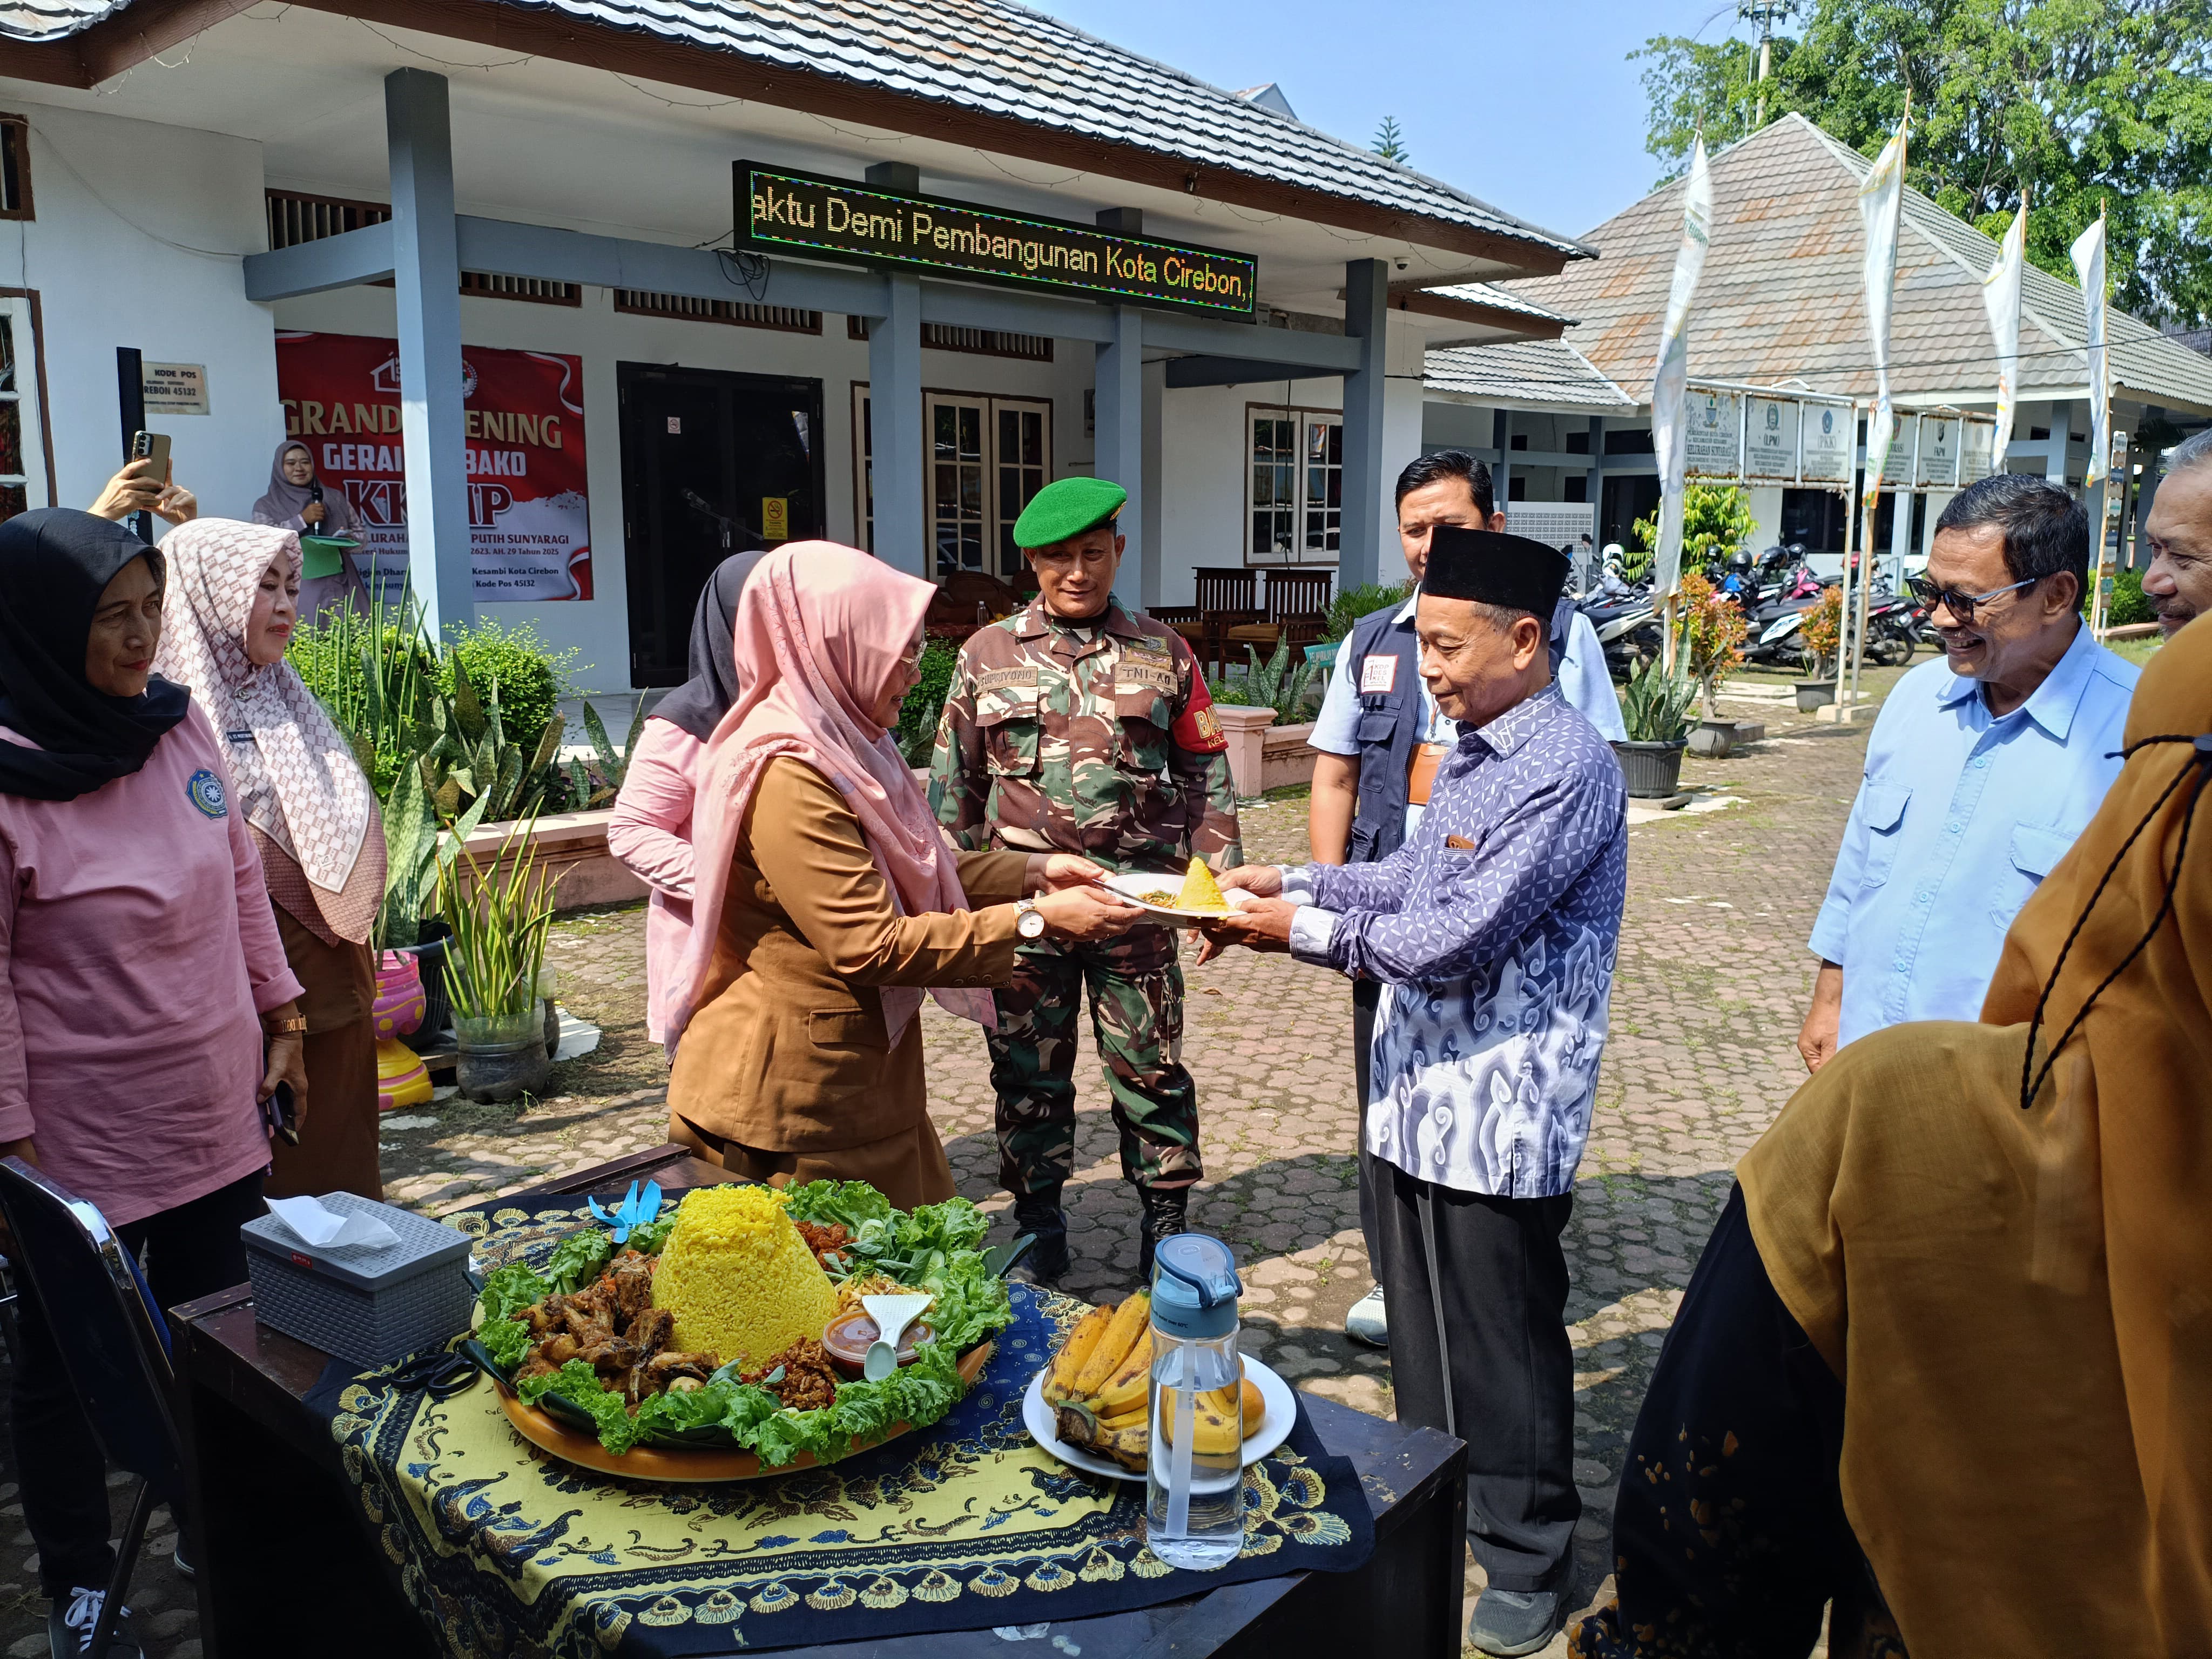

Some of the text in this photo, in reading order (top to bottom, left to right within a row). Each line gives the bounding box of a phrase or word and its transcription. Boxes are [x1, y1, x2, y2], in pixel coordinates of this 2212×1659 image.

[827, 197, 902, 242] Demi
[913, 212, 1097, 271] Pembangunan
[1107, 246, 1157, 283] Kota
[1164, 257, 1246, 302] Cirebon,
[144, 386, 196, 396] REBON 45132
[280, 399, 562, 448] GRAND ENING
[323, 443, 527, 476] GERAI BAKO
[471, 534, 504, 543] PUTIH
[508, 535, 569, 544] SUNYARAGI
[1122, 667, 1170, 685] TNI-AD
